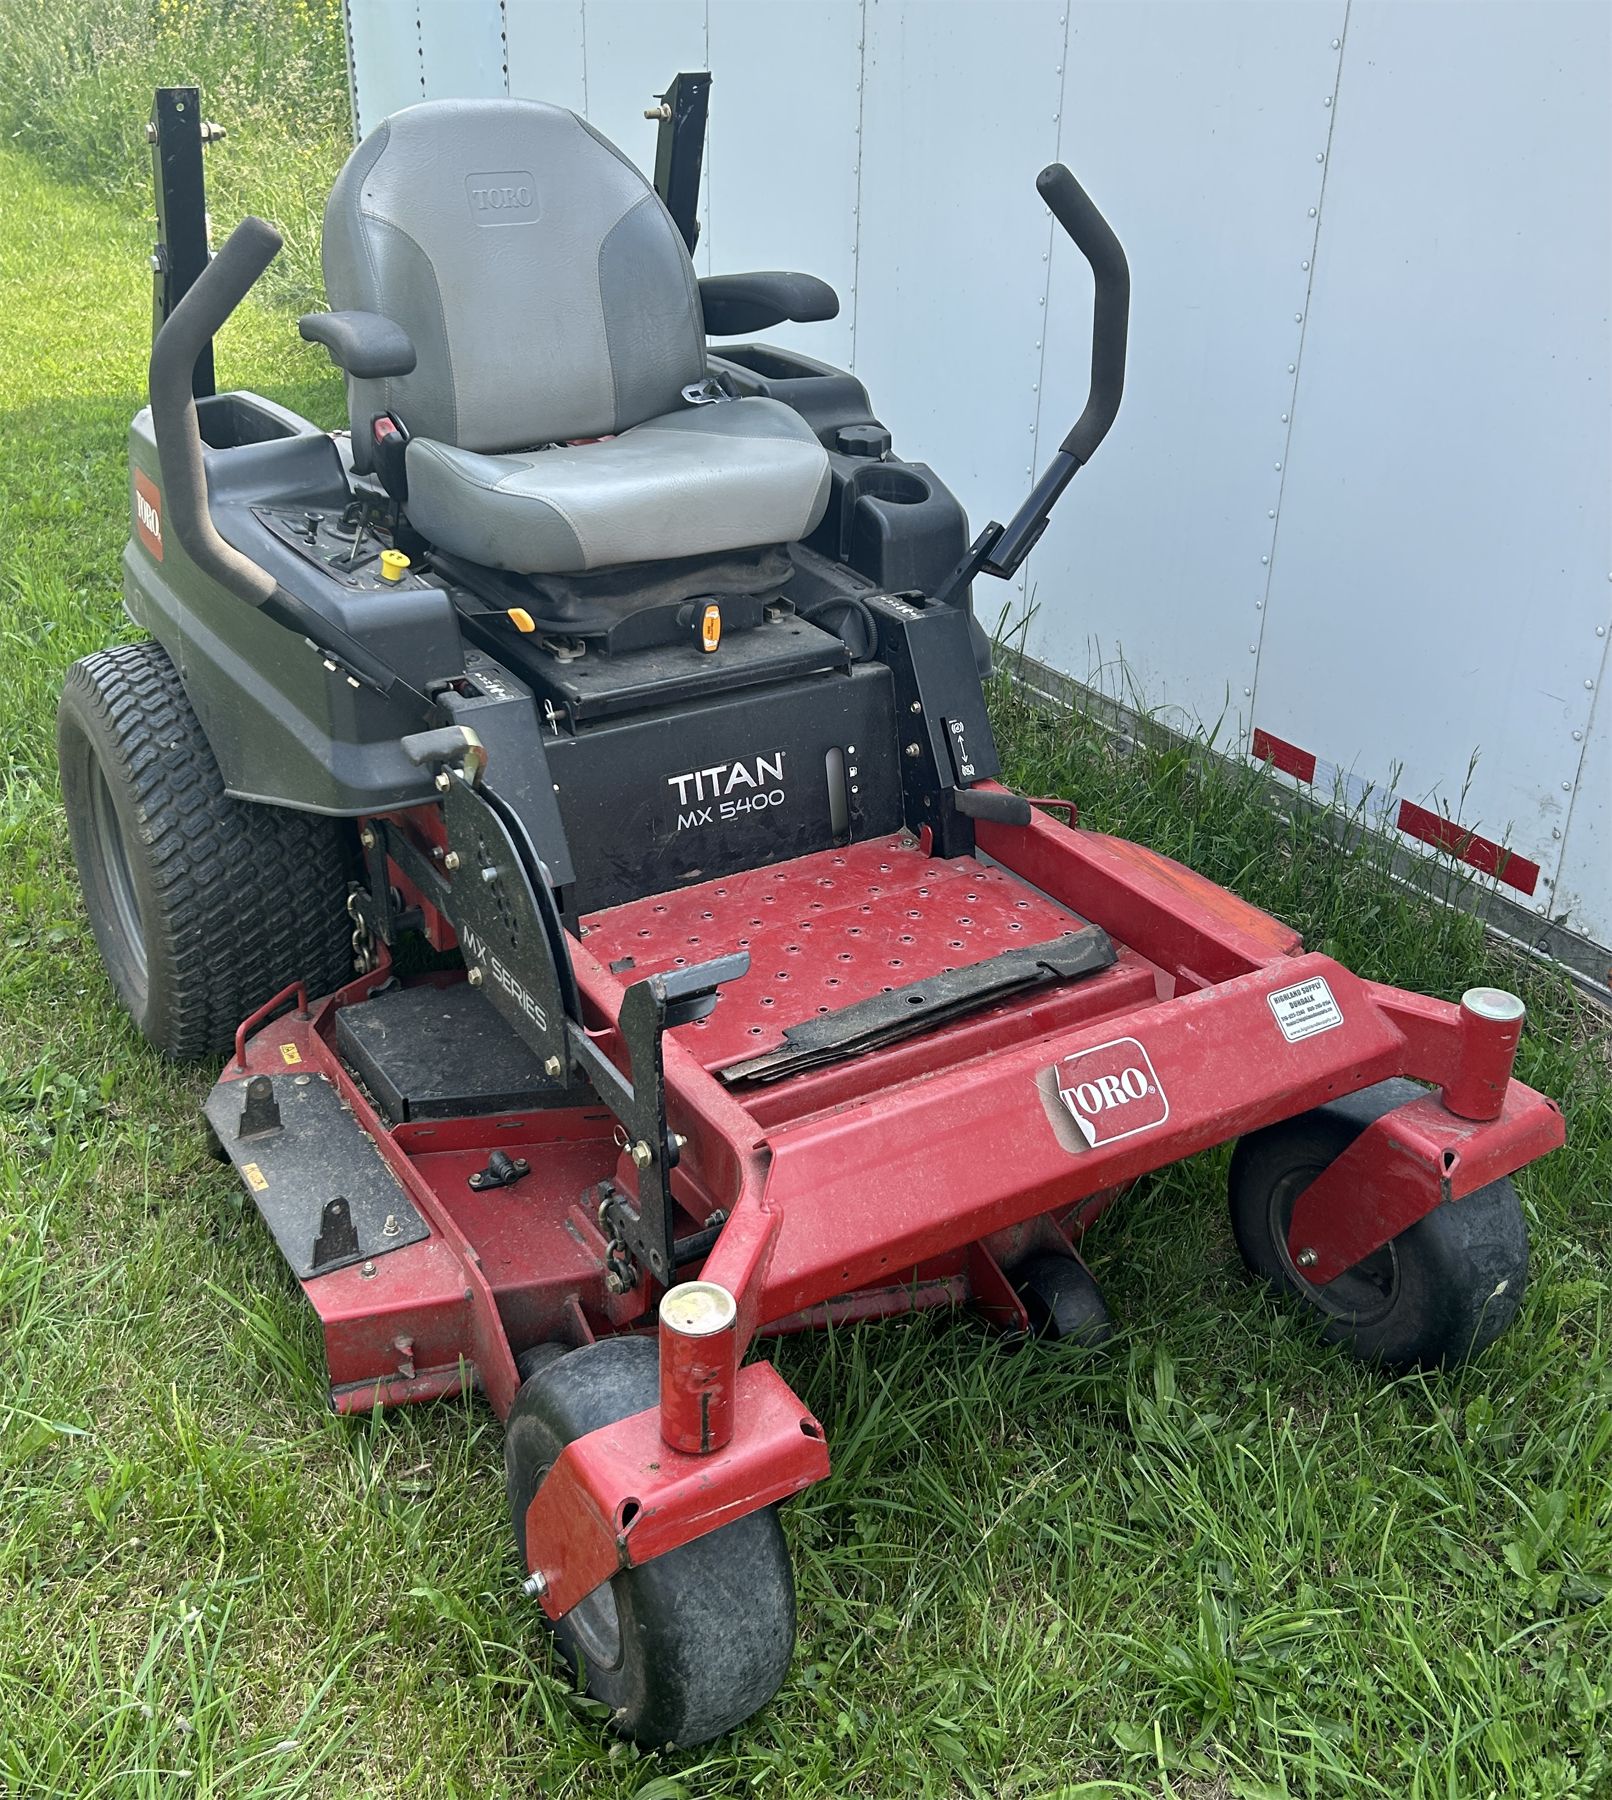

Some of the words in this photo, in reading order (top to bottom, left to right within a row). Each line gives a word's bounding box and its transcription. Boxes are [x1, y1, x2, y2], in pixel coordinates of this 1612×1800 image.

[472, 186, 533, 210] TORO
[136, 489, 160, 537] TORO
[668, 752, 783, 805] TITAN
[677, 806, 714, 831] MX
[719, 789, 785, 820] 5400
[463, 925, 487, 966] MX
[491, 957, 547, 1032] SERIES
[1273, 988, 1302, 1005] HIGHLAND
[1300, 980, 1322, 995] SUPPLY
[1288, 994, 1316, 1010] DUNDALK
[1059, 1067, 1148, 1118] TORO
